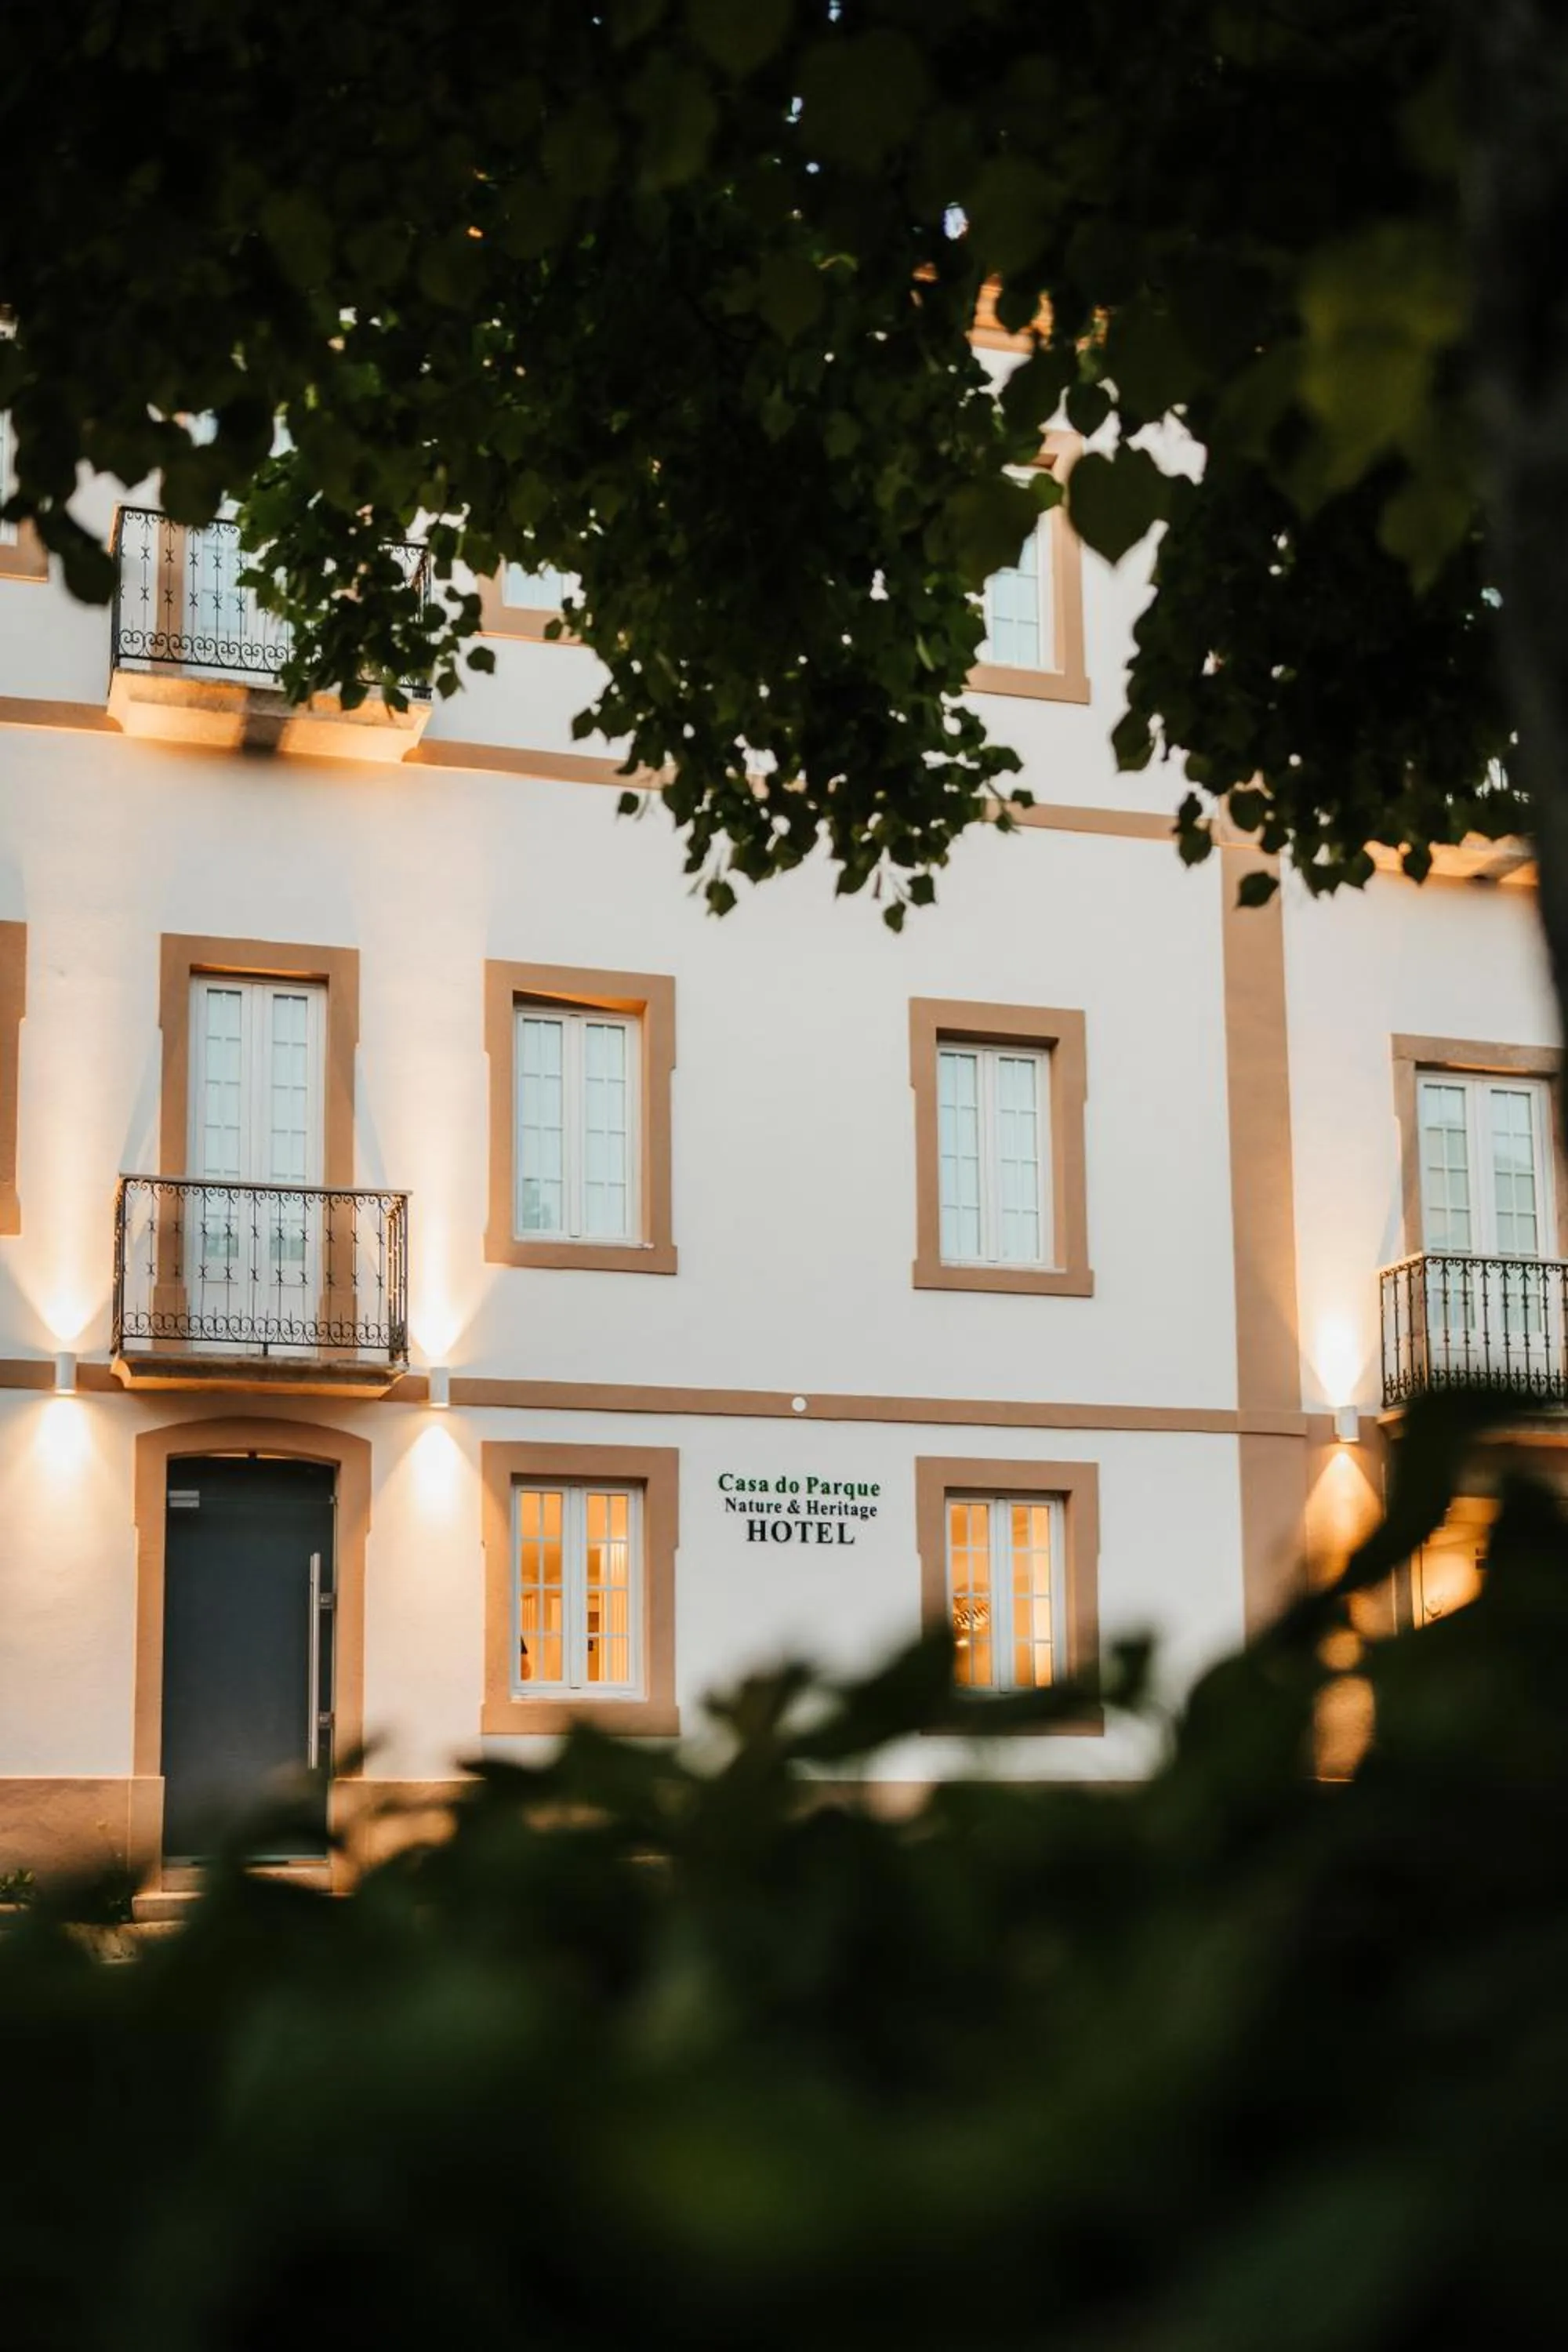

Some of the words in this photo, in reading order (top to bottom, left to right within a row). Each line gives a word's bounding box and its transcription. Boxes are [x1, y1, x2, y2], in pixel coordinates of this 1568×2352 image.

[717, 1472, 770, 1494] Casa
[775, 1475, 800, 1494] do
[805, 1476, 880, 1501] Parque
[724, 1497, 782, 1515] Nature
[786, 1498, 801, 1515] &
[806, 1499, 878, 1521] Heritage
[746, 1519, 856, 1545] HOTEL
